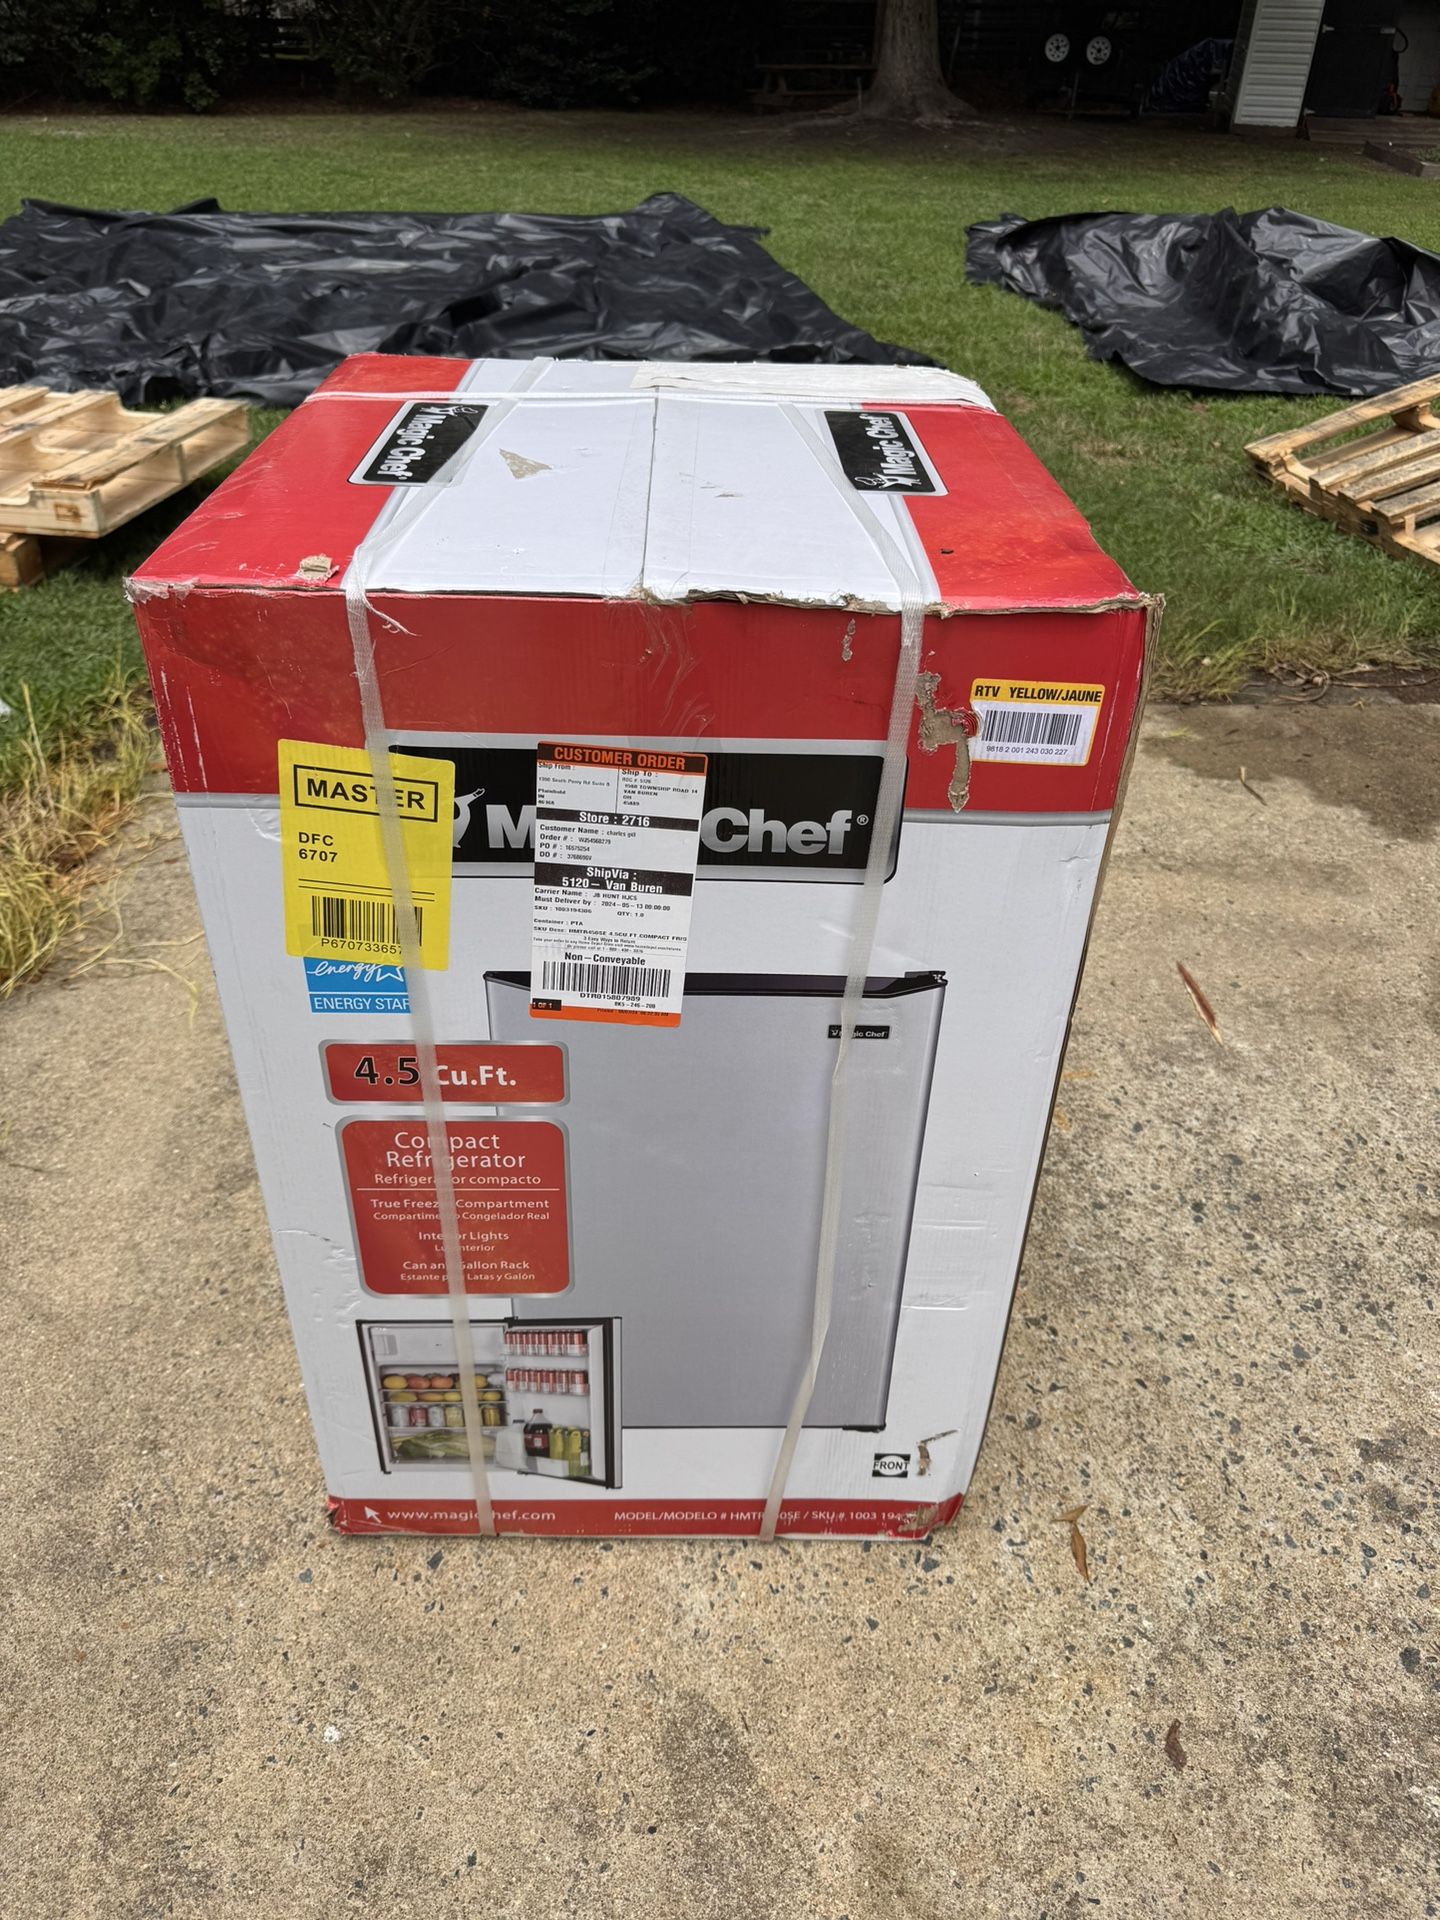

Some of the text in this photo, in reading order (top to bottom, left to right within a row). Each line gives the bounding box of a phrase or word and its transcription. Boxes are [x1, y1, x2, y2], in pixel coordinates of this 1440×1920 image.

[377, 414, 447, 478] Magic Chef
[859, 416, 917, 475] Magic Chef
[975, 685, 1102, 702] RTV YELLOW/JAUNE
[1005, 746, 1010, 754] 2
[1041, 748, 1054, 756] 030
[1055, 748, 1068, 756] 227
[554, 746, 686, 770] CUSTOMER ORDER
[622, 768, 640, 776] Ship
[579, 812, 609, 824] Store
[622, 814, 650, 827] 2716
[540, 824, 575, 834] Customer
[578, 826, 599, 835] Name
[298, 831, 334, 847] DFC
[298, 848, 338, 863] 6707
[586, 867, 629, 882] ShipVia
[606, 880, 626, 891] Van
[630, 882, 663, 894] Buren
[314, 997, 372, 1010] ENERGY
[353, 1055, 517, 1086] 4.5 Cu.Ft.
[394, 1131, 500, 1151] Copact
[386, 1150, 526, 1171] Refrgerator
[468, 1174, 542, 1187] compacto
[370, 1199, 550, 1210] True Freez Compartment
[462, 1212, 525, 1222] Congelador
[527, 1212, 550, 1220] Real
[470, 1232, 510, 1242] Lights
[402, 1261, 428, 1270] Can
[430, 1261, 446, 1270] an
[500, 1261, 530, 1270] Rack
[400, 1273, 440, 1281] Estante
[467, 1273, 495, 1281] Latas
[496, 1274, 503, 1282] y
[504, 1272, 536, 1281] Galón
[873, 1461, 910, 1470] FRONT
[614, 1511, 717, 1521] MODEL/MODELO
[811, 1511, 834, 1521] SKU
[850, 1512, 877, 1521] 1003
